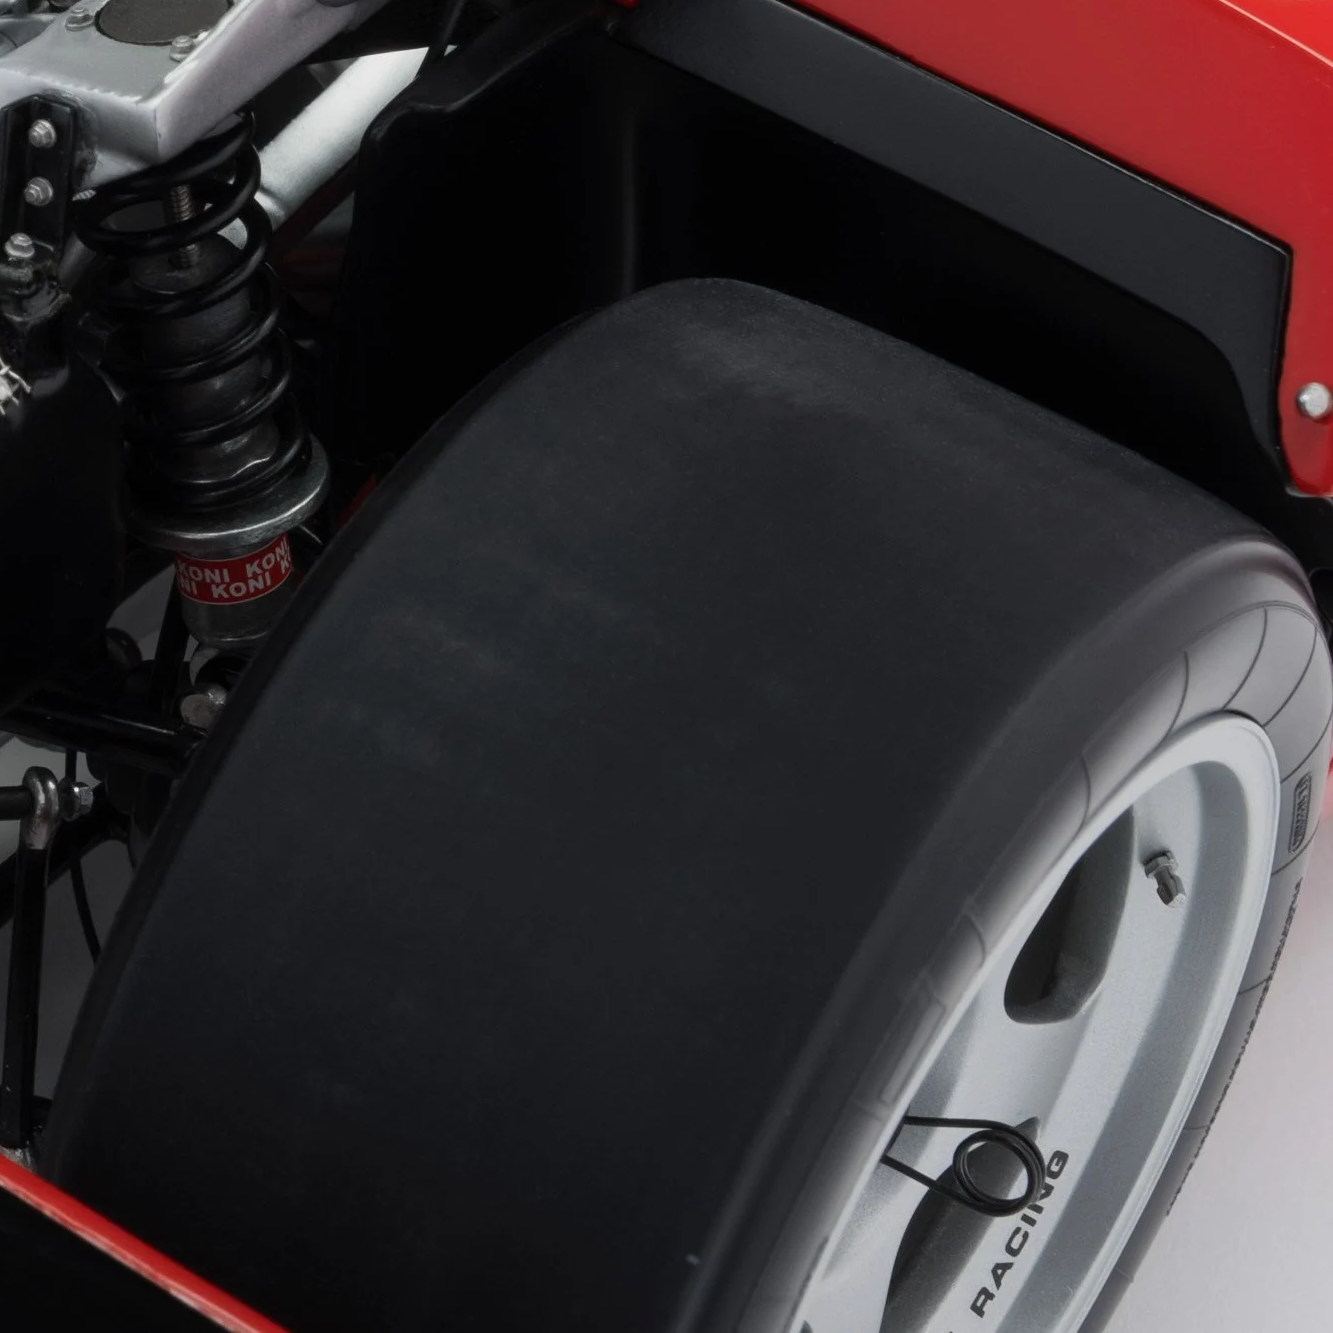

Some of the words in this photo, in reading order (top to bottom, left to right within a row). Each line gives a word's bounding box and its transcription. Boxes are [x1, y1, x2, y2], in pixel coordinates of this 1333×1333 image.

[176, 559, 230, 584] KONI
[211, 570, 272, 599] KONI
[969, 1149, 1070, 1319] RACING
